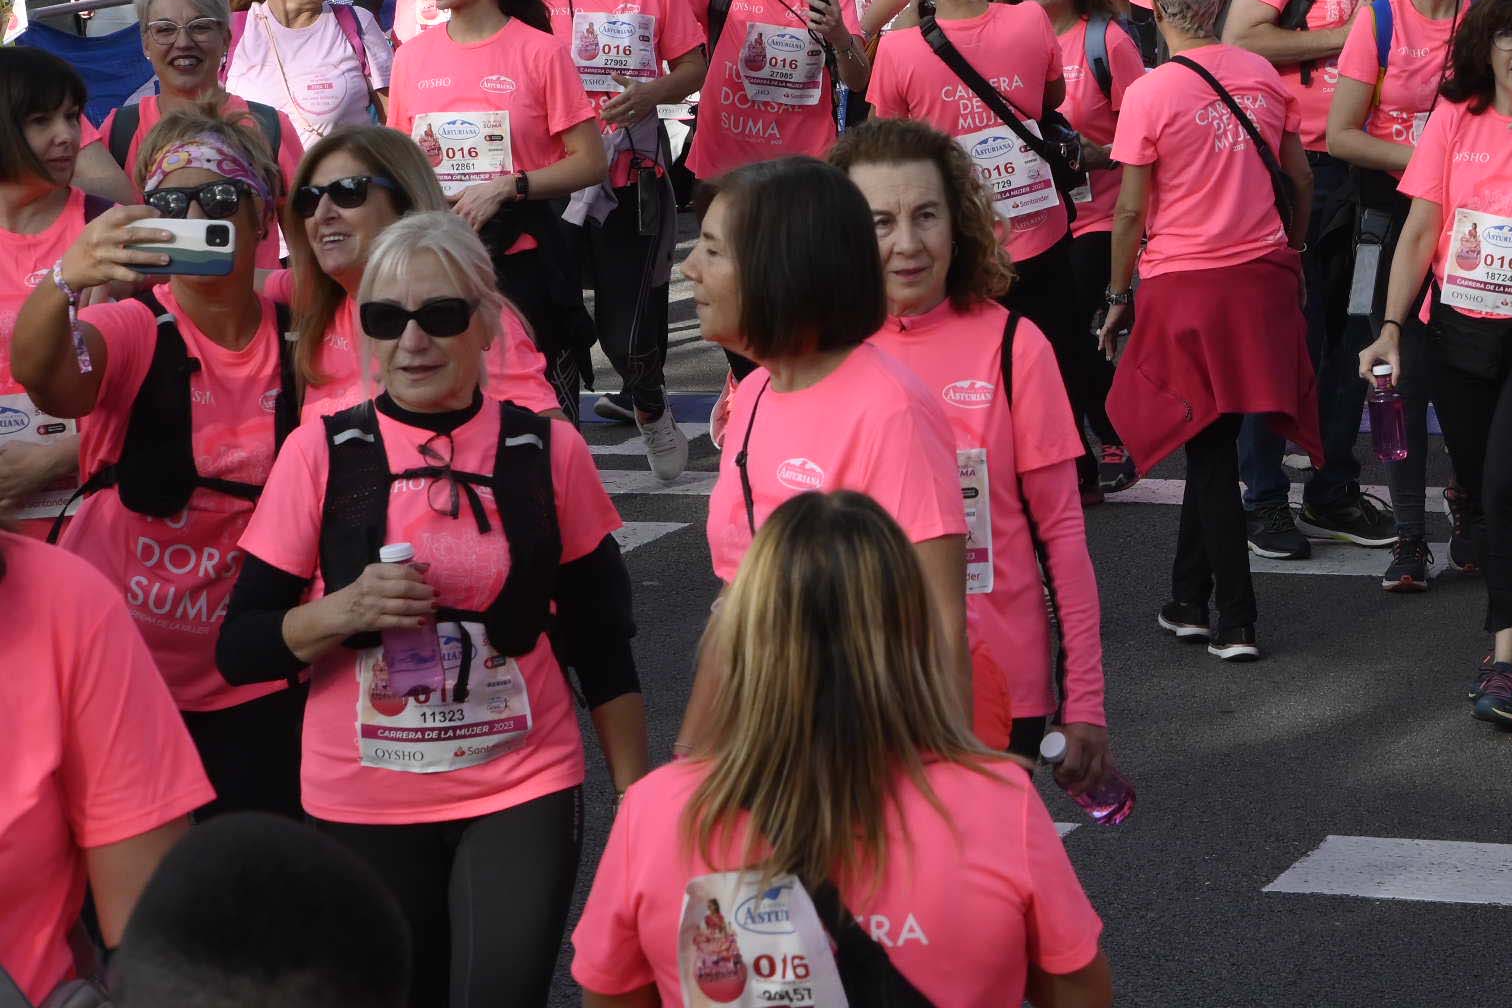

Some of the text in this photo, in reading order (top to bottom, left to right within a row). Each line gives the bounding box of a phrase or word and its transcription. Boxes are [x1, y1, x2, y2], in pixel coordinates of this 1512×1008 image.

[602, 44, 632, 56] 016
[604, 59, 628, 67] 27992
[769, 56, 798, 70] 016
[418, 78, 451, 90] OYSHO
[942, 75, 1024, 102] CAERA
[960, 98, 985, 115] DE
[1195, 93, 1267, 126] CARERA
[721, 111, 780, 138] SUMA
[958, 112, 1004, 130] MUJ
[1213, 113, 1233, 135] DE
[442, 127, 477, 136] ASTURIANA
[446, 146, 479, 160] 016
[974, 142, 1012, 157] ASTURIANA
[451, 163, 475, 171] 12861
[983, 161, 1016, 179] 016
[992, 179, 1012, 190] 729
[1019, 195, 1049, 208] Santander
[1457, 278, 1485, 289] CARRERA
[1486, 271, 1512, 283] 18724
[1451, 290, 1484, 304] OYSHO
[946, 389, 993, 402] ASTURIAN
[777, 466, 823, 489] ASTURIANA
[959, 468, 976, 477] MA
[135, 535, 240, 579] DORS
[420, 708, 465, 724] 11323
[377, 720, 514, 739] CARRERA DE LA MUJER 2023
[374, 747, 424, 762] OYSHO
[754, 953, 811, 980] 016
